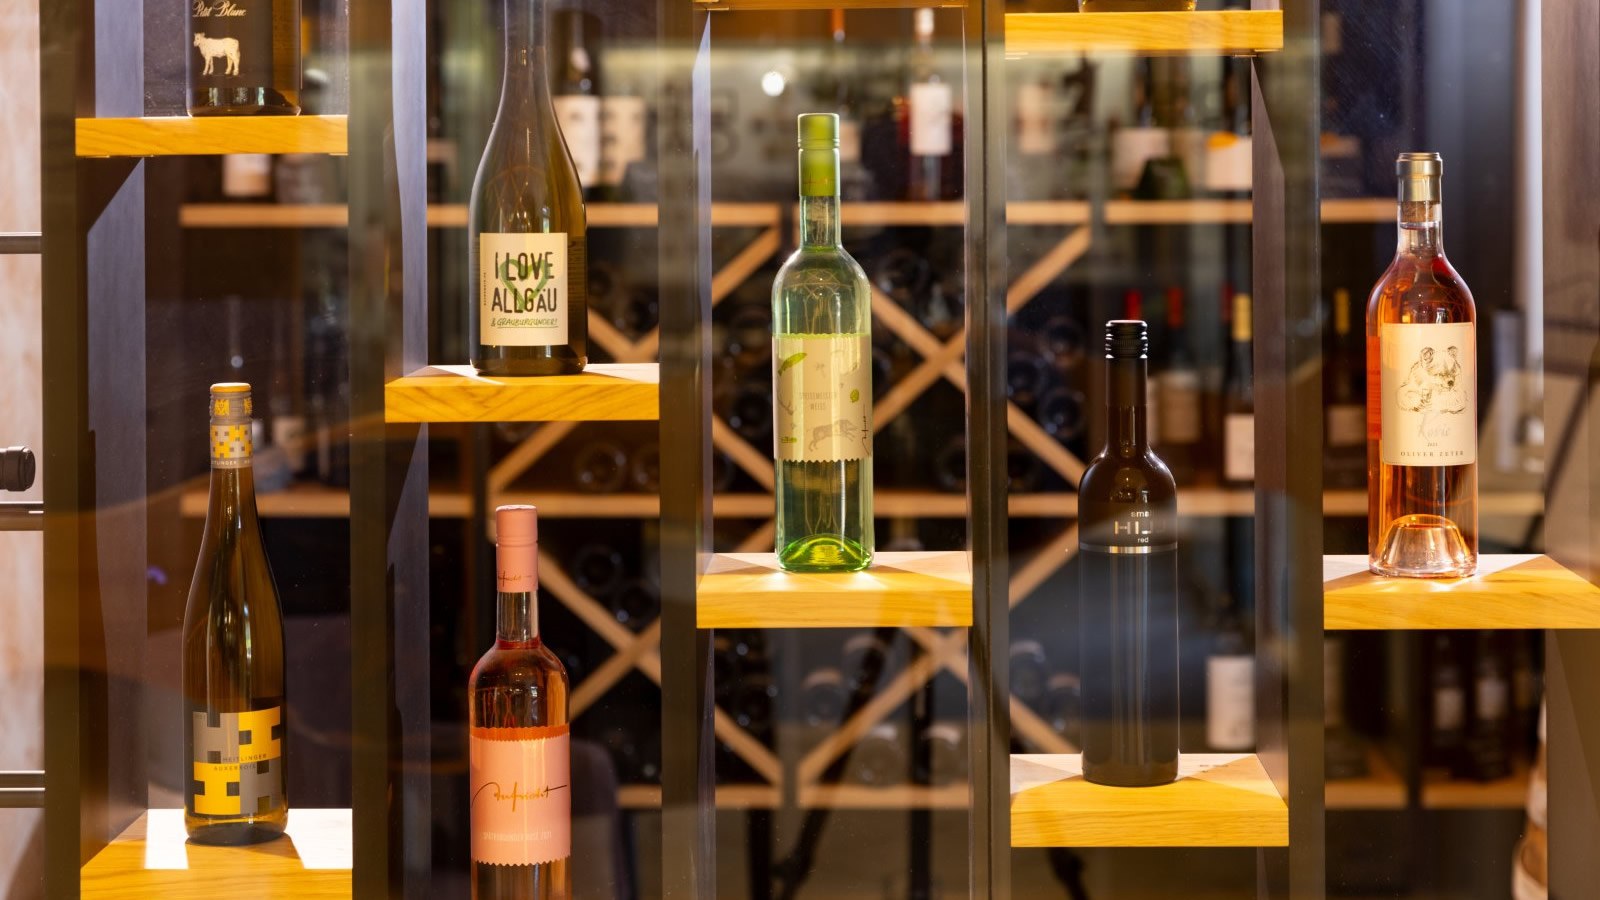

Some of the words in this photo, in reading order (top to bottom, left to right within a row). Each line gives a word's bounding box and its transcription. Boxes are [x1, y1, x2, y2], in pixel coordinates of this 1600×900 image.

[213, 0, 247, 17] Blanc
[495, 252, 499, 280] I
[506, 252, 555, 281] LOVE
[491, 286, 557, 314] ALLGÄU
[1400, 450, 1435, 458] OLIVER
